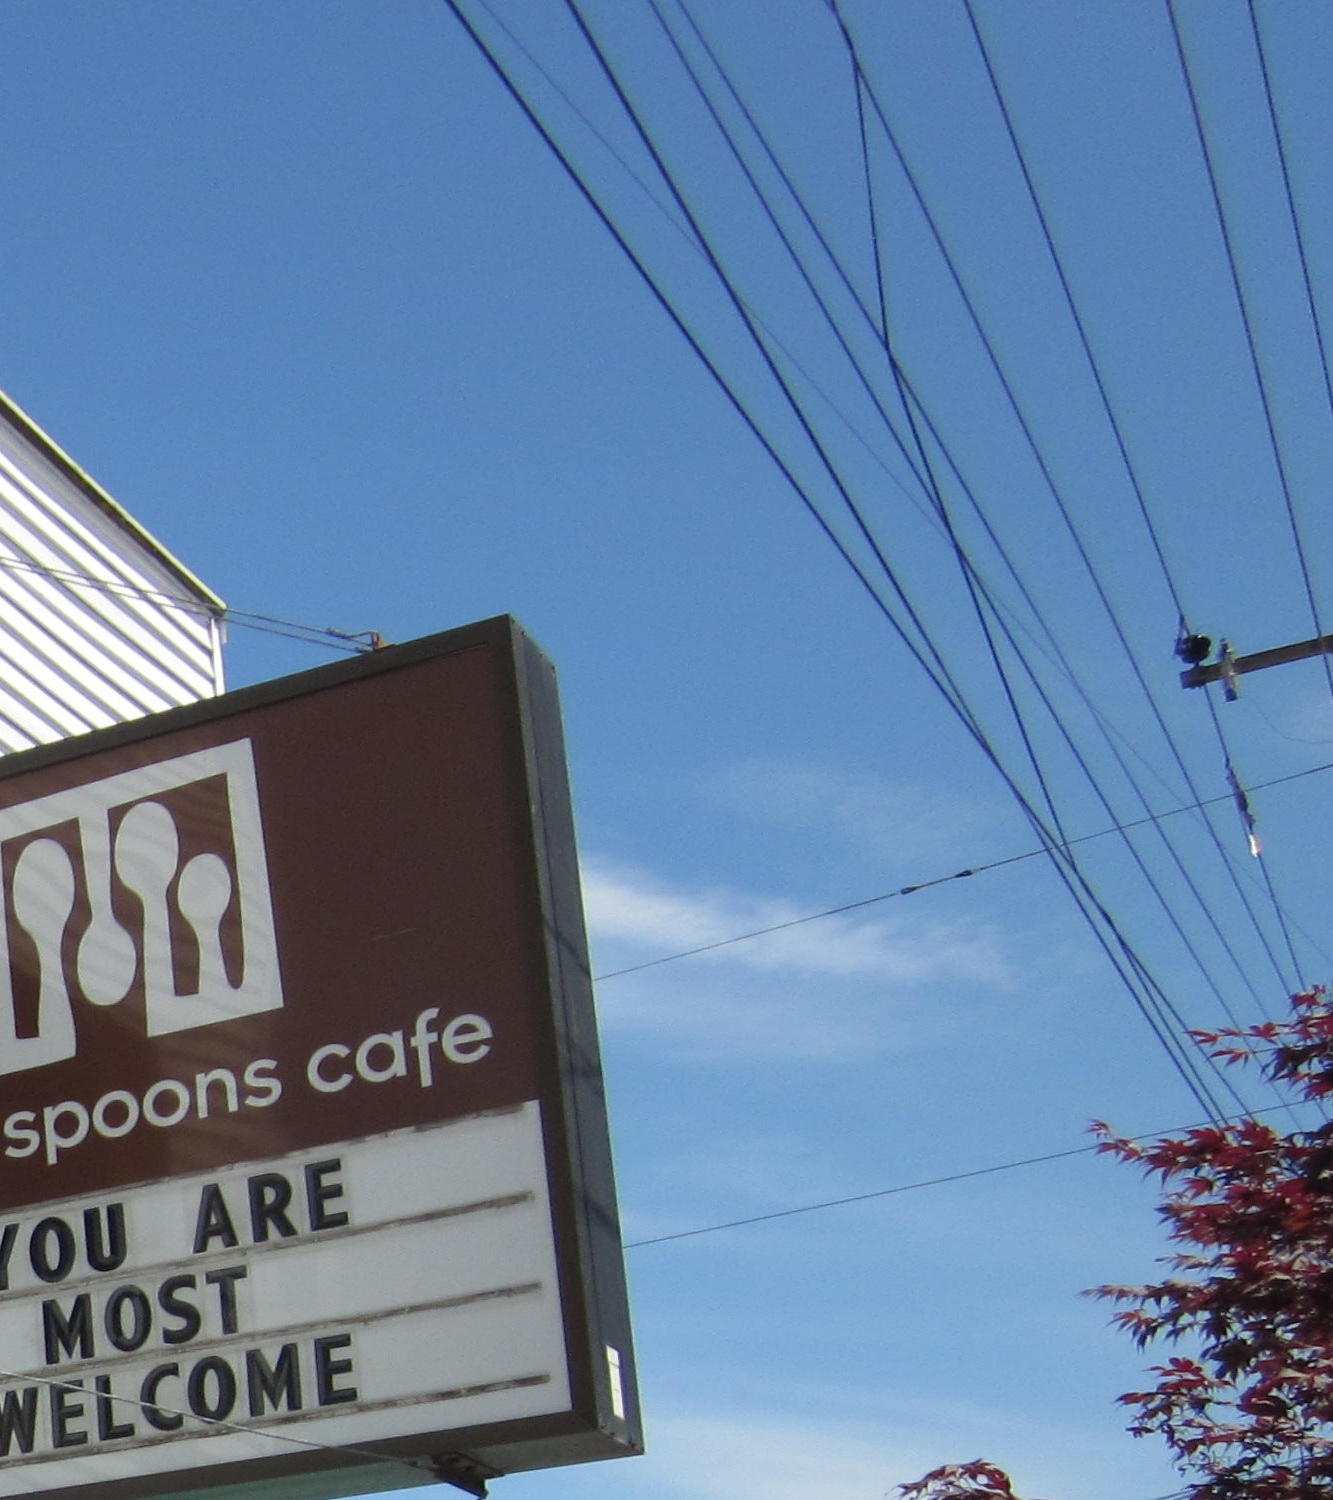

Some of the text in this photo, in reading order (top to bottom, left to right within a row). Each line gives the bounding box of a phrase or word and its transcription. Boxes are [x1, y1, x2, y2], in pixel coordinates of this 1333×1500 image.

[2, 1058, 283, 1166] spoons
[306, 1006, 494, 1093] cafe
[192, 1157, 350, 1254] ARE
[41, 1265, 248, 1366] MOST
